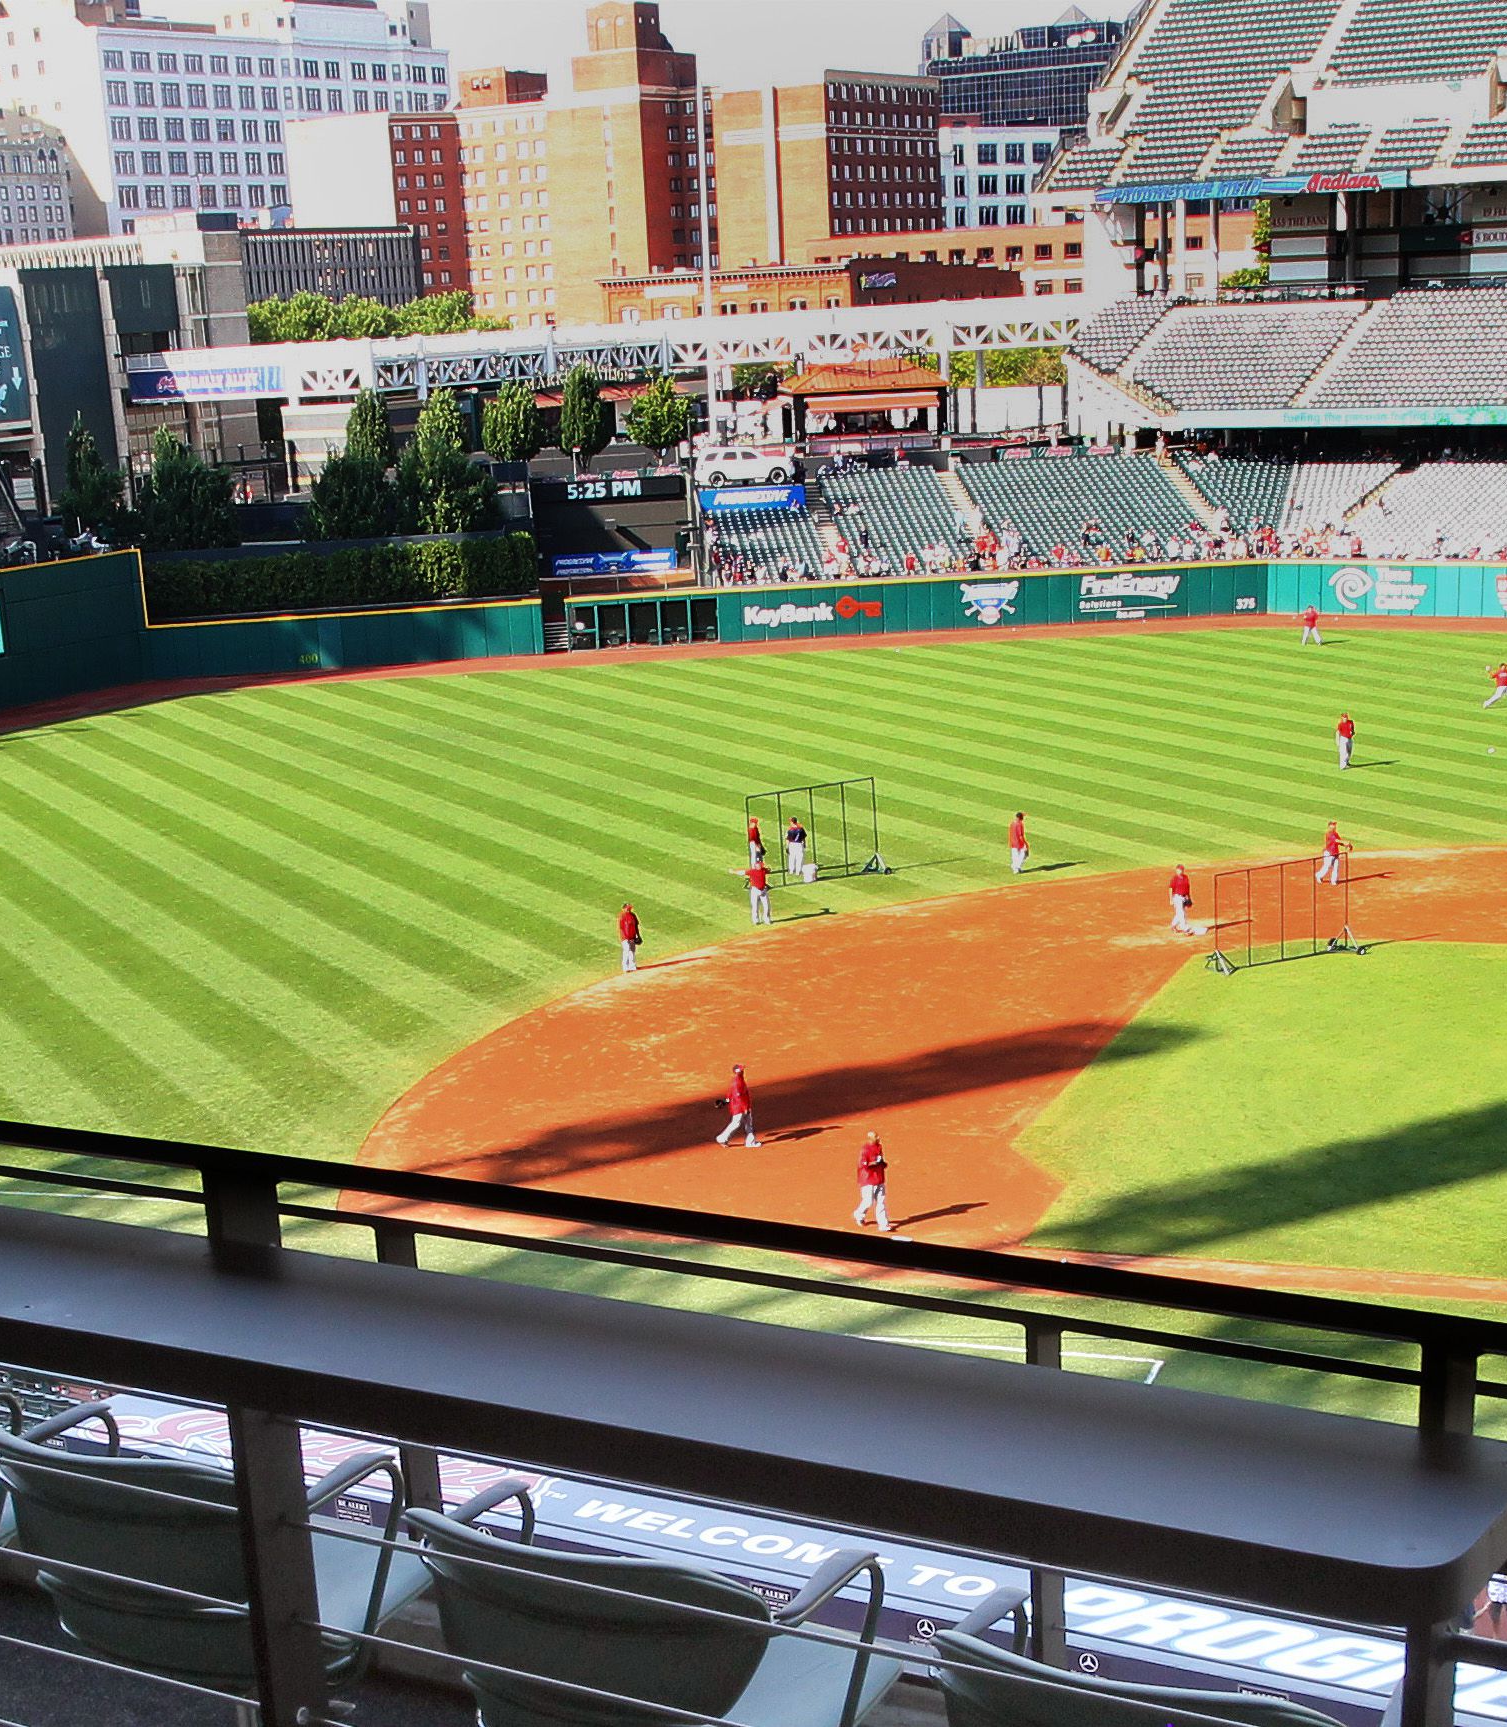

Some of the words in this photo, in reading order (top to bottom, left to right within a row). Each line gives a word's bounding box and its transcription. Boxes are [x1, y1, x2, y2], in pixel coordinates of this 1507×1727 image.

[1304, 172, 1383, 194] Indians
[1288, 217, 1303, 227] THE
[1305, 215, 1328, 227] FANS
[1482, 207, 1492, 217] 19
[568, 482, 606, 500] 5:25
[613, 480, 641, 496] PM
[1080, 573, 1181, 596] FirstEnergy
[744, 602, 834, 628] KeyBank
[347, 1501, 368, 1511] ALERT
[912, 1563, 997, 1597] TO
[764, 1588, 791, 1601] ALERT
